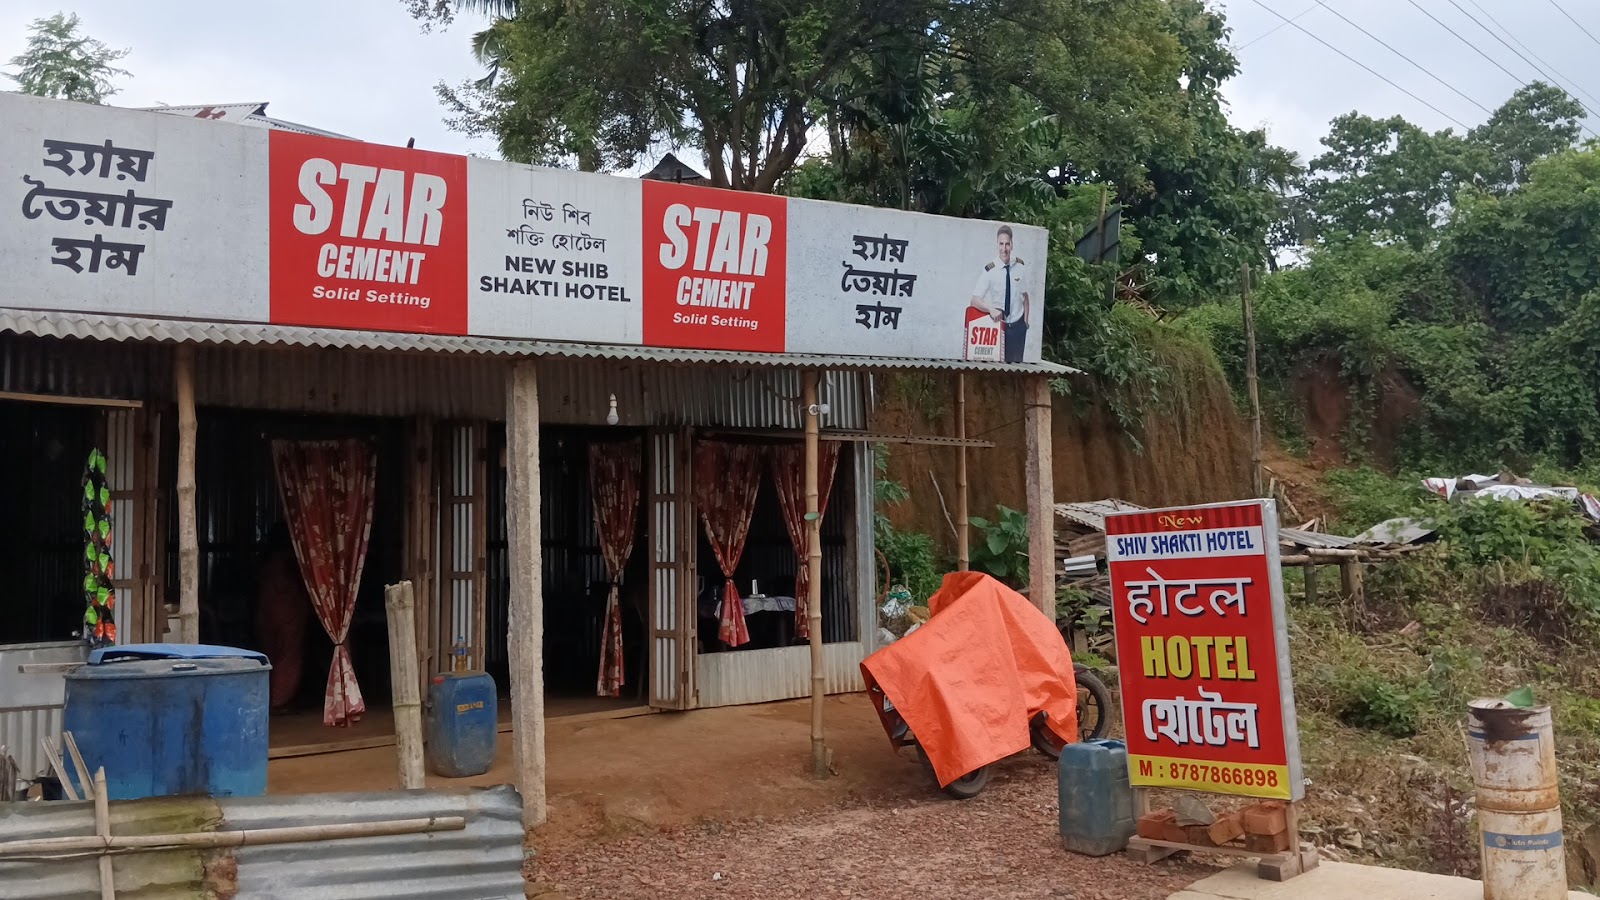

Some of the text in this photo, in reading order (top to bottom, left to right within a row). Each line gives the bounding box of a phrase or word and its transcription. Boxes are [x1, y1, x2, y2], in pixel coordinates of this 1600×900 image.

[43, 139, 154, 182] হ্যায়
[22, 175, 173, 231] তৈয়ার
[293, 157, 448, 247] STAR
[522, 198, 592, 226] নিউ শিব
[505, 224, 607, 253] শক্তি হোটেল
[659, 203, 772, 277] STAR
[852, 233, 909, 263] হ্যায়
[51, 234, 145, 275] হাম
[317, 243, 426, 285] CEMENT
[505, 255, 609, 279] NEW SHIB
[479, 276, 631, 302] SHAKTI HOTEL
[676, 276, 756, 310] CEMENT
[841, 261, 918, 298] তৈয়ার
[312, 285, 431, 309] Solid Setting
[673, 312, 759, 331] Solid Setting
[855, 301, 903, 330] হাম
[971, 326, 999, 346] STAR
[974, 346, 994, 355] CEMENT
[1158, 514, 1204, 529] New
[1116, 530, 1255, 557] SHIV SHAKTI HOTEL
[1124, 566, 1252, 624] होटल
[1140, 635, 1256, 680] HOTEL
[1141, 685, 1259, 748] হোটেল
[1138, 760, 1153, 777] M
[1169, 762, 1279, 788] 8787866898
